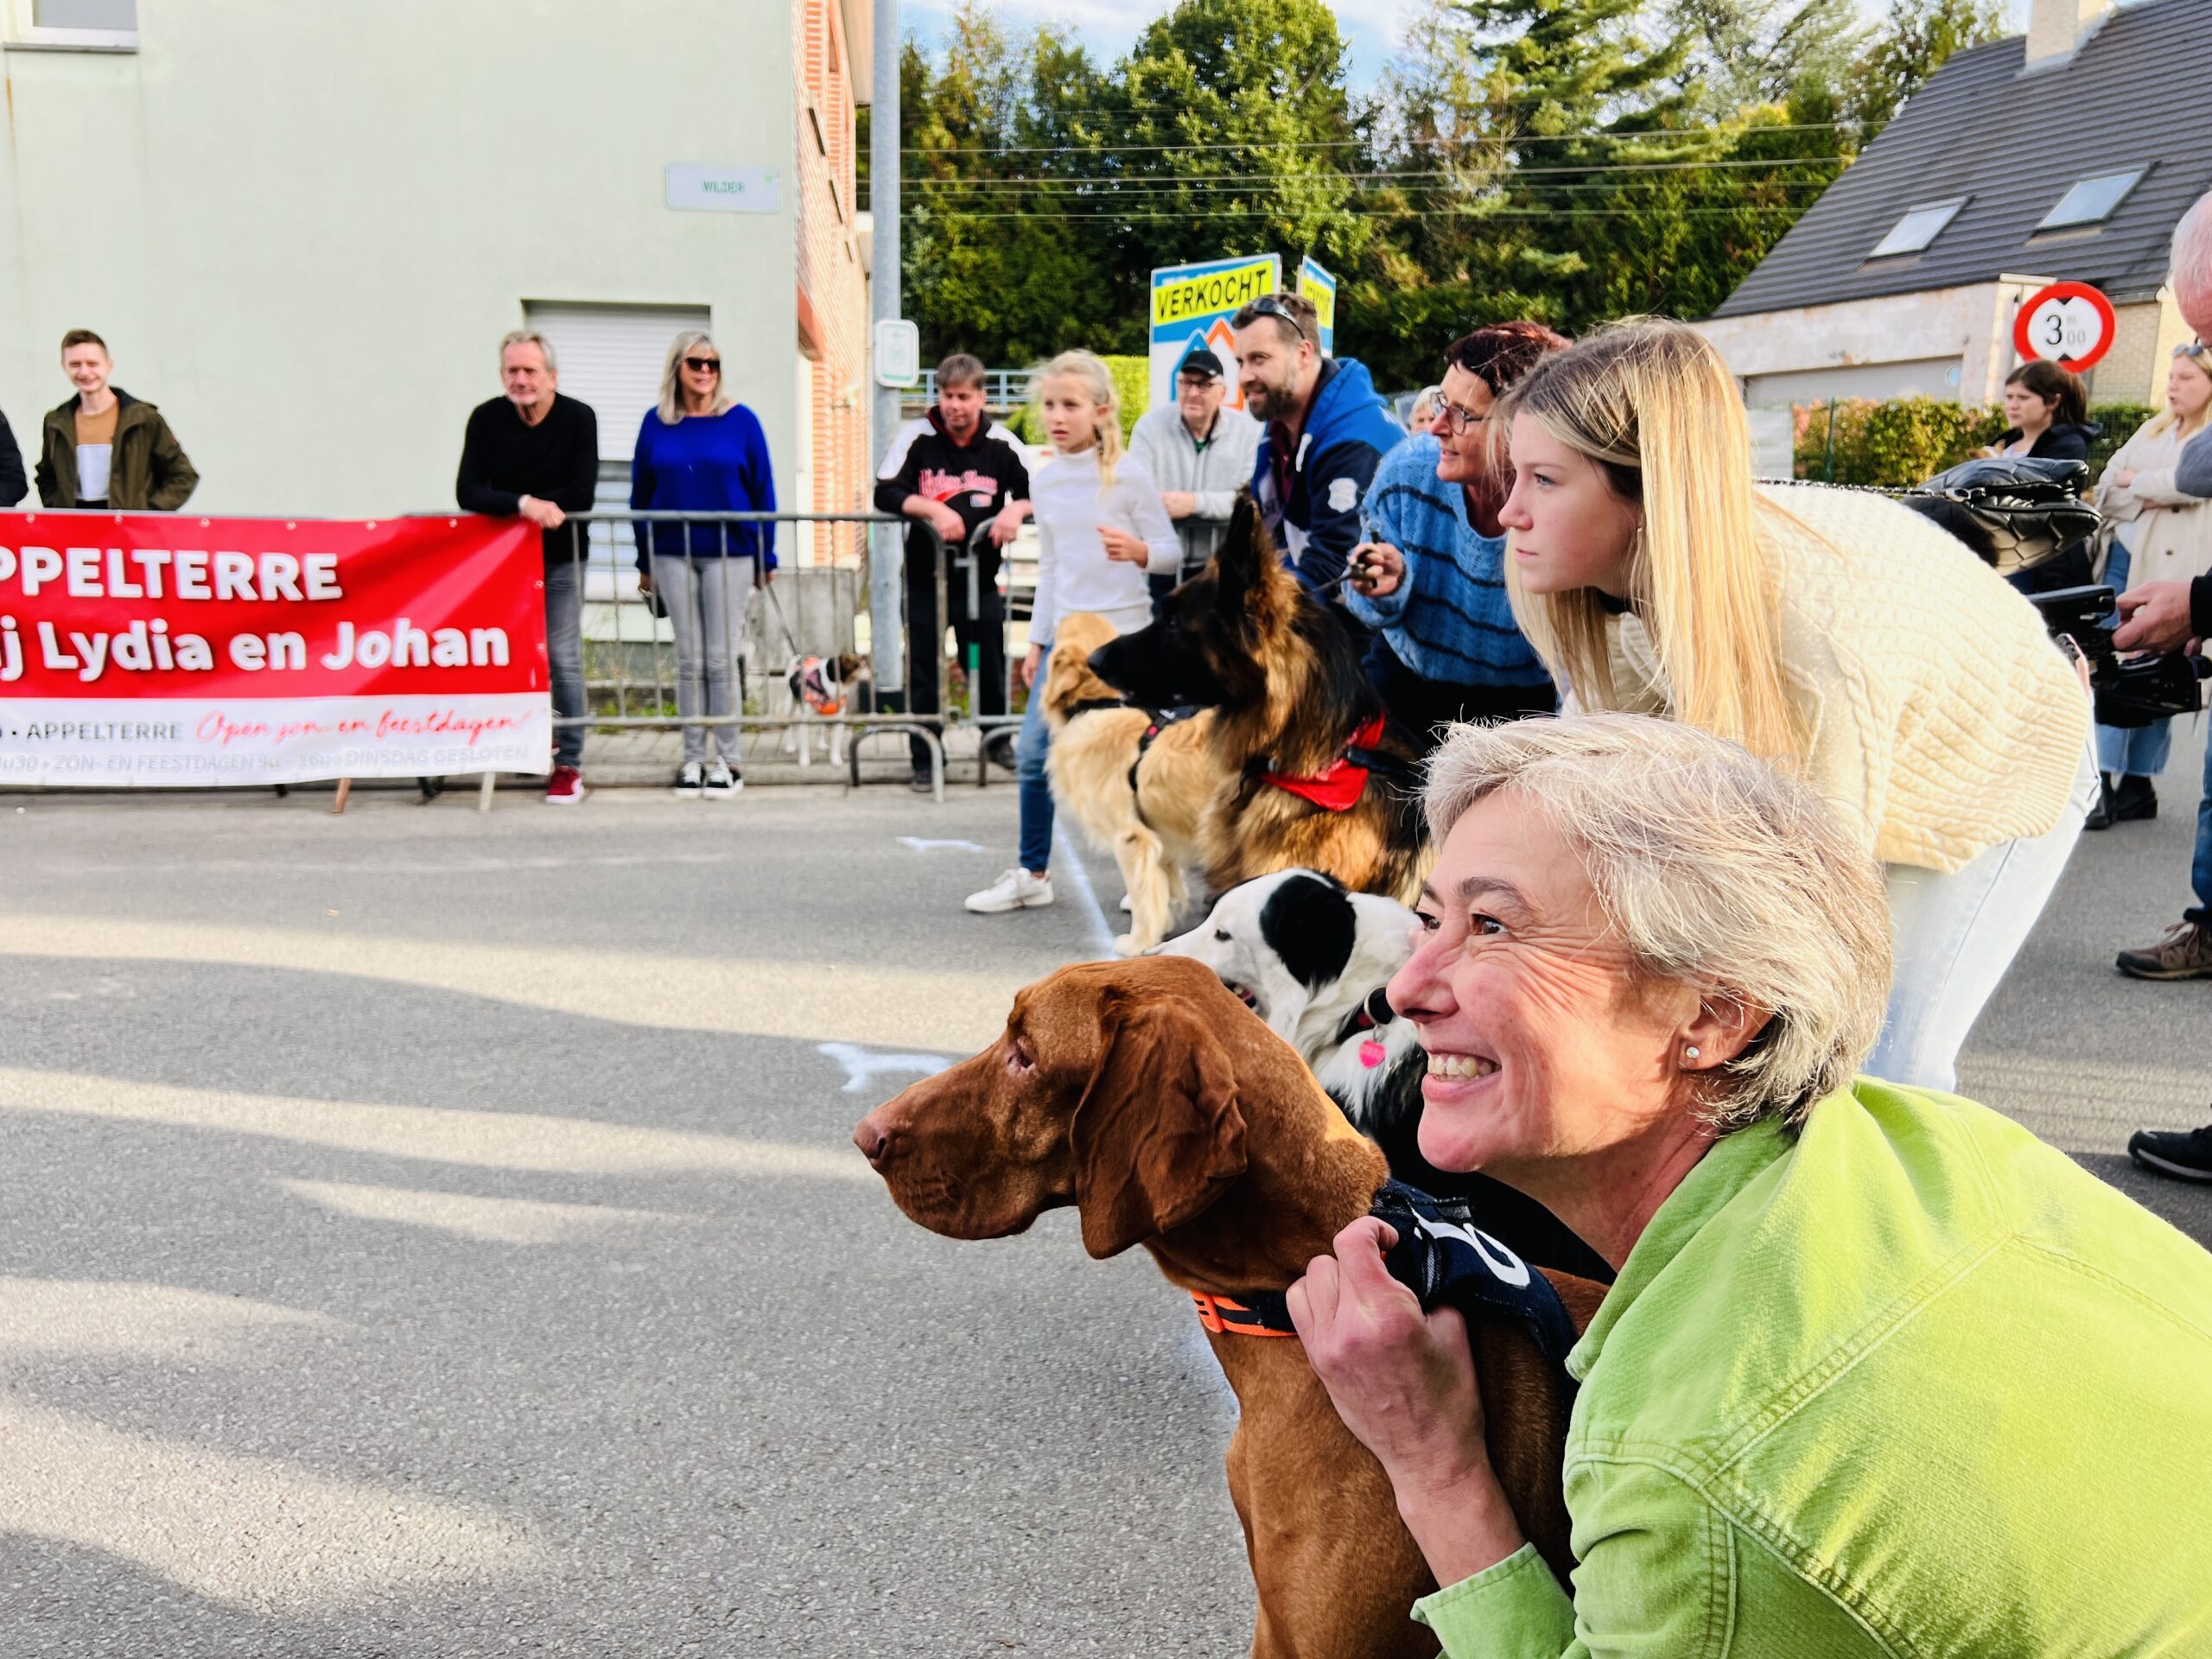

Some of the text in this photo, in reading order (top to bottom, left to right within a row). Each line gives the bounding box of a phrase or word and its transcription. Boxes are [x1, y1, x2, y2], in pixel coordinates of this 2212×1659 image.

[1155, 269, 1267, 318] VERKOCHT
[2045, 315, 2063, 346] 3
[2066, 329, 2087, 346] 00
[36, 617, 214, 682] Lydia
[229, 632, 306, 671] en
[321, 617, 510, 671] Johan
[26, 721, 183, 741] APPELTERRE
[196, 710, 271, 747] Open
[338, 720, 368, 733] en
[0, 754, 39, 772] u30
[106, 754, 131, 772] EN
[137, 753, 253, 773] FEESTDAGEN
[346, 748, 429, 766] DINSDAG
[434, 746, 528, 766] GESLOTEN
